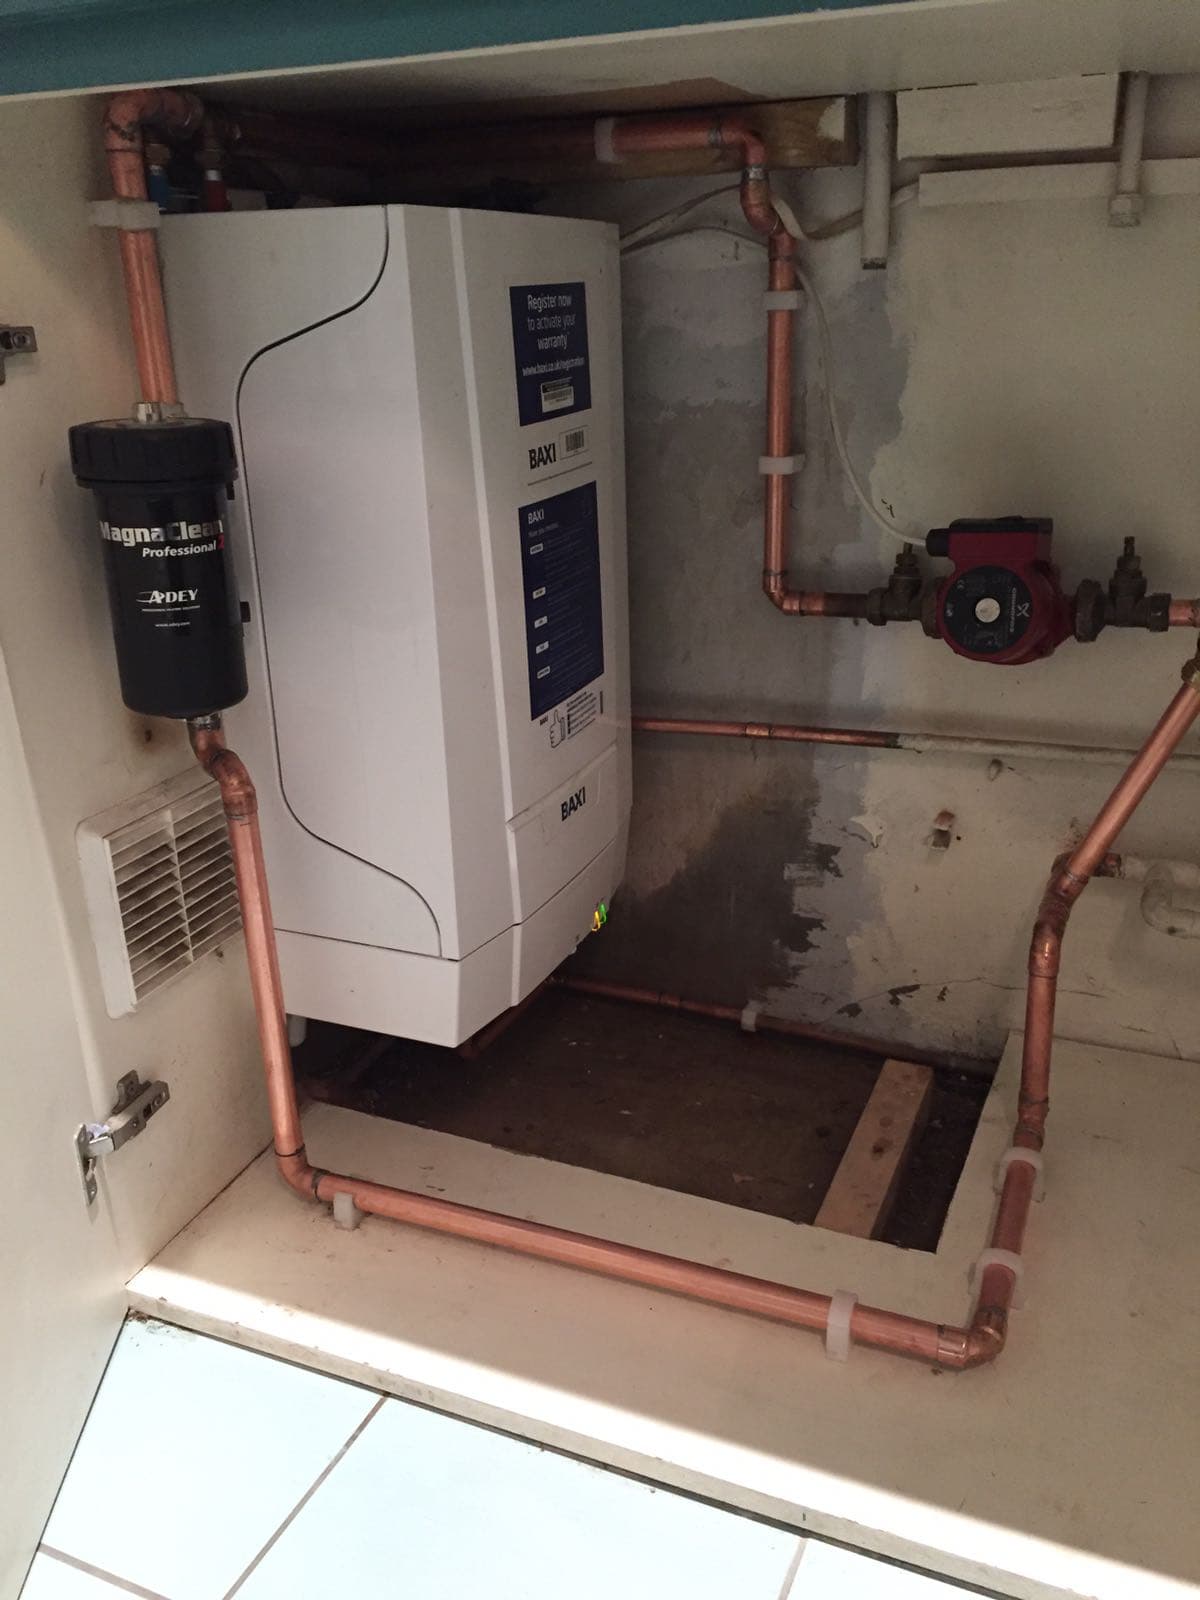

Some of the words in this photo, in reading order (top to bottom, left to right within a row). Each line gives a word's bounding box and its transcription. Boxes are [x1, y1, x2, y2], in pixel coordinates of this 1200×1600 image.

[527, 294, 557, 312] Register
[558, 295, 572, 307] now
[527, 317, 535, 331] to
[536, 315, 562, 330] activate
[562, 314, 576, 330] your
[528, 443, 556, 470] BAXI
[528, 509, 544, 525] BAXI
[142, 540, 217, 557] Professional
[148, 588, 198, 604] ADEY
[561, 786, 585, 821] BAXI
